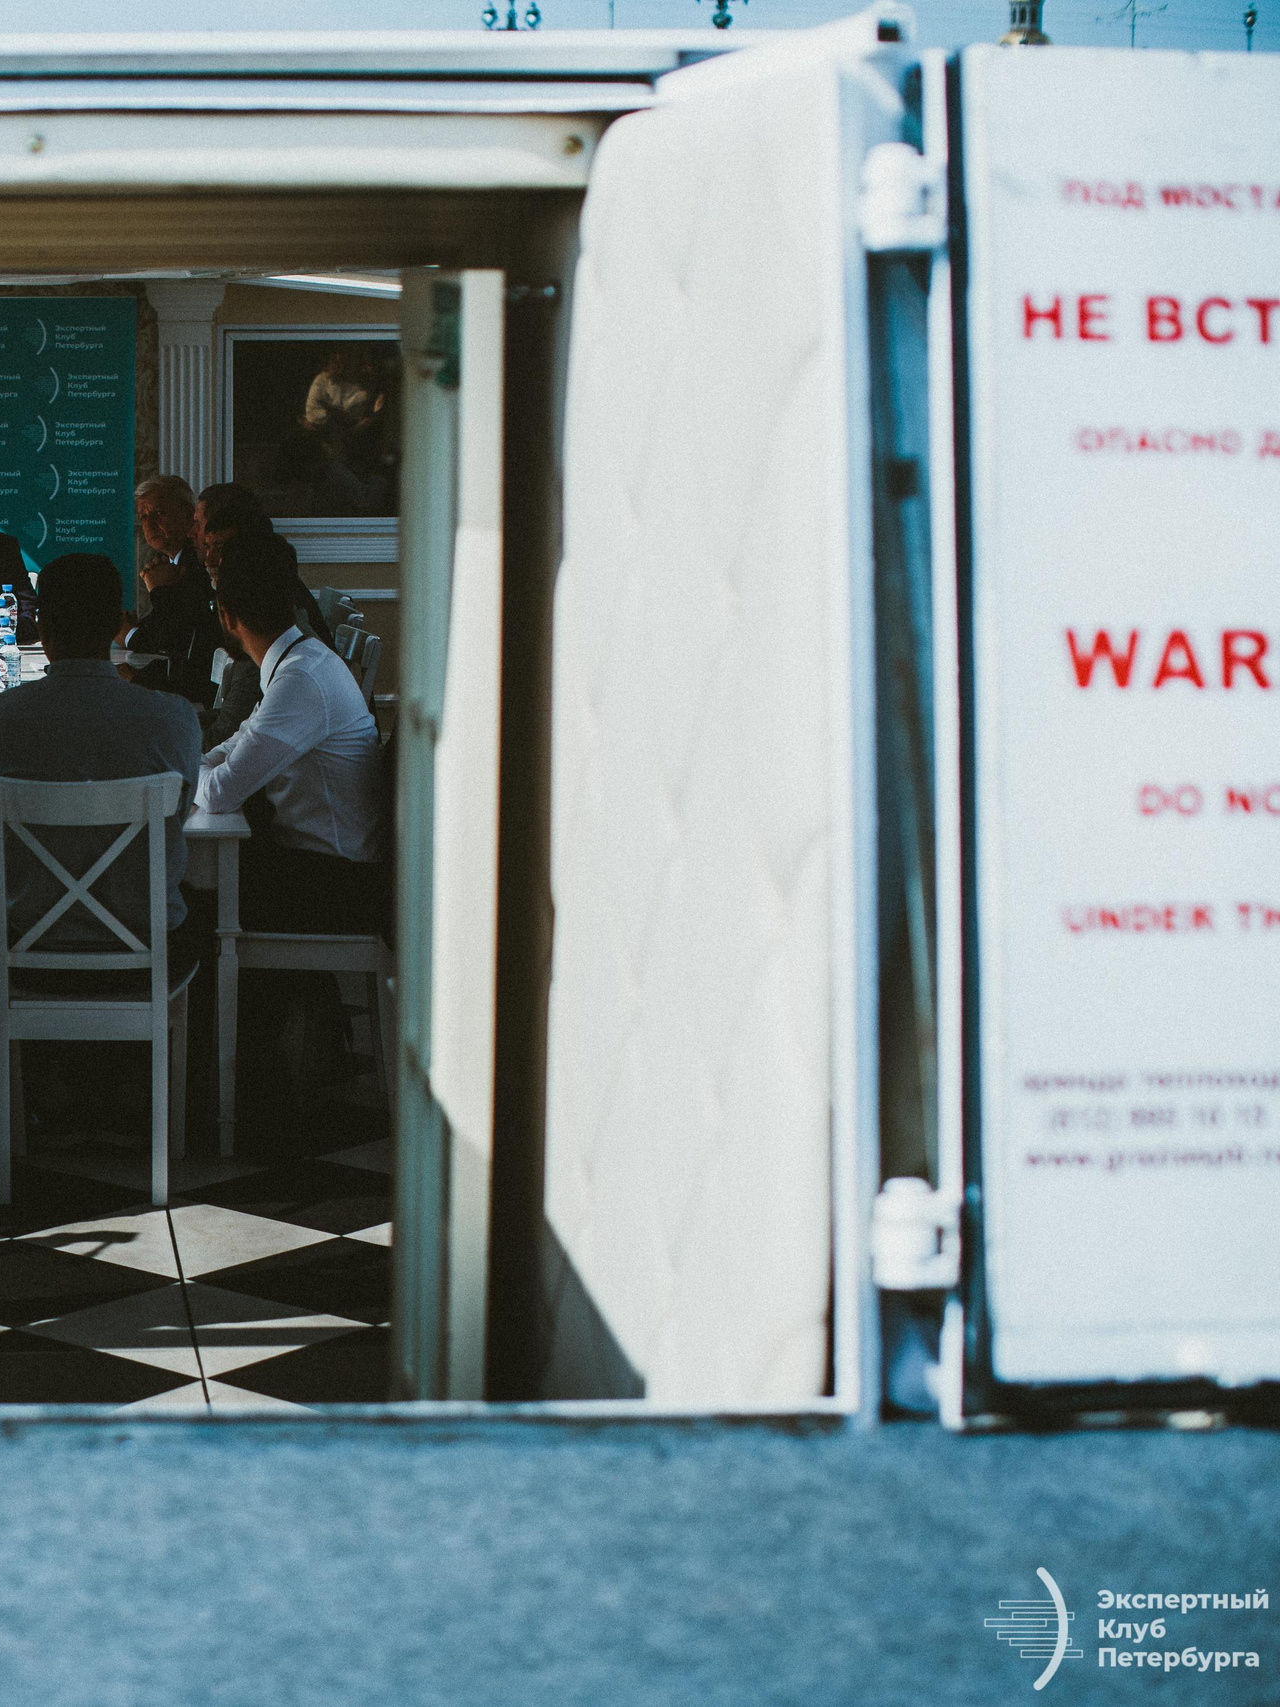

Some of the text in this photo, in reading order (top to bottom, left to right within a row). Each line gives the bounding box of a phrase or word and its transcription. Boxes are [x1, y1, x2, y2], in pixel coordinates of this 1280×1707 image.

[1159, 180, 1280, 211] МОСТ
[1021, 293, 1280, 345] НЕ ВСТ
[55, 325, 106, 333] Экспертный
[55, 342, 104, 350] Петербурга
[68, 374, 119, 382] Экспертный
[68, 382, 88, 390] Клуб
[68, 390, 116, 398] Петербурга
[55, 422, 106, 430] Экспертный
[55, 430, 76, 438] Клуб
[55, 439, 104, 447] Петербурга
[68, 470, 119, 478] Экспертный
[68, 478, 88, 486] Клуб
[68, 487, 116, 495] Петербурга
[56, 518, 106, 526] Экспертный
[56, 535, 104, 543] Петербурга
[1064, 629, 1270, 688] WAR
[1138, 784, 1202, 817] DO
[1062, 904, 1213, 935] UNDER
